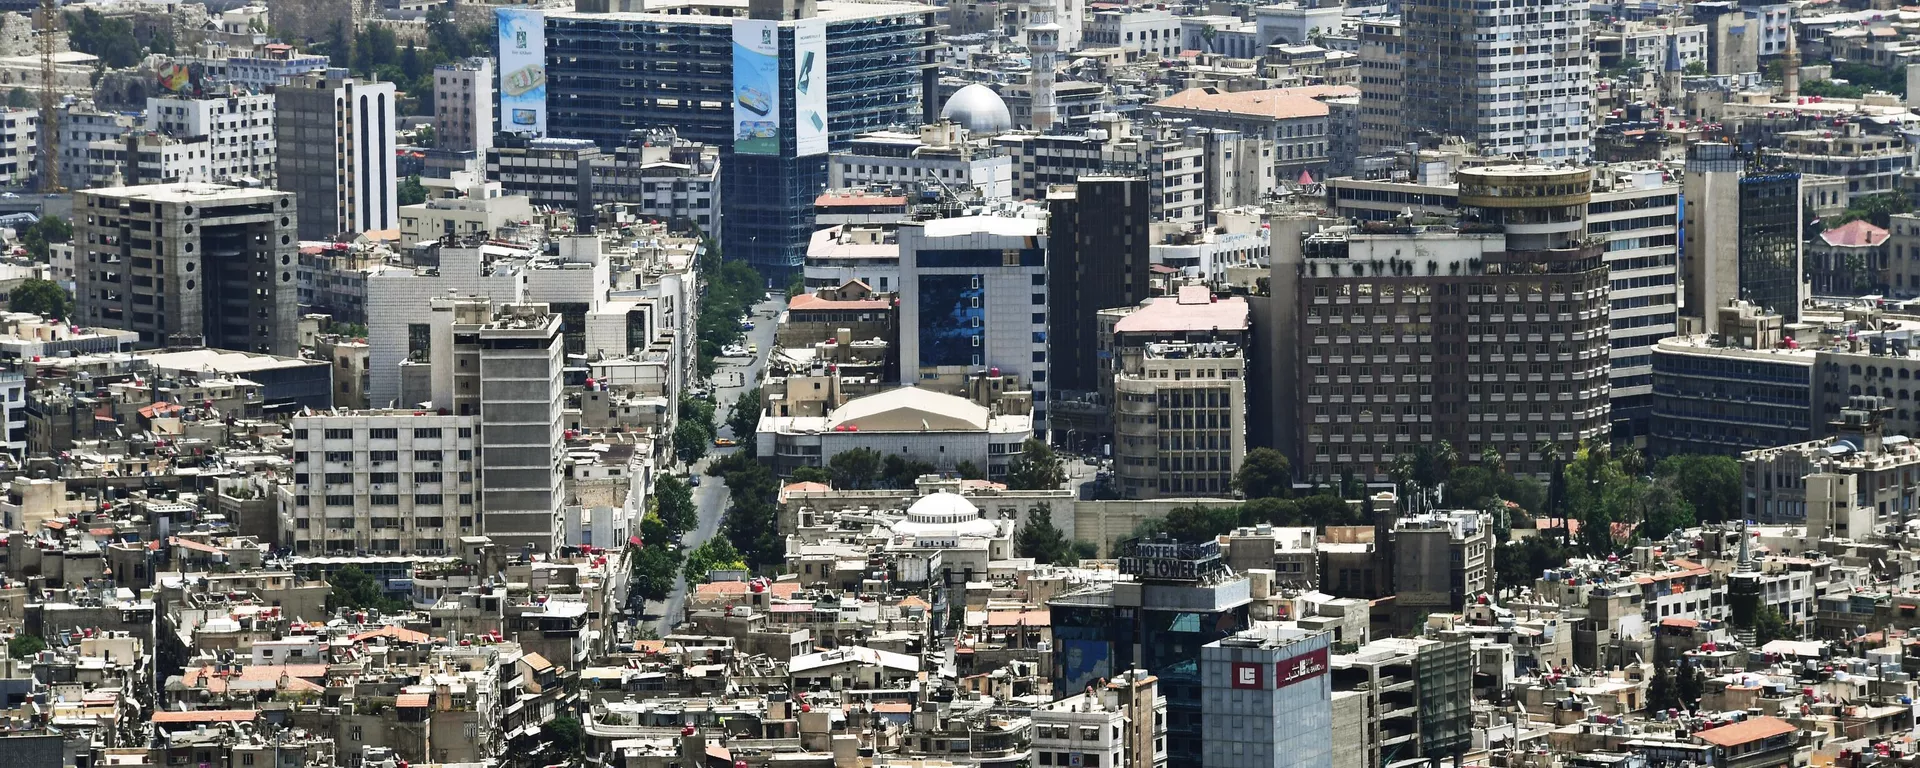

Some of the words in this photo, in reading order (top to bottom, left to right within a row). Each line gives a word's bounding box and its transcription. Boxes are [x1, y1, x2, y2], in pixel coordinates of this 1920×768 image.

[1136, 545, 1177, 557] HOTEL
[1119, 558, 1150, 576] BLUE
[1152, 559, 1195, 578] TOWER
